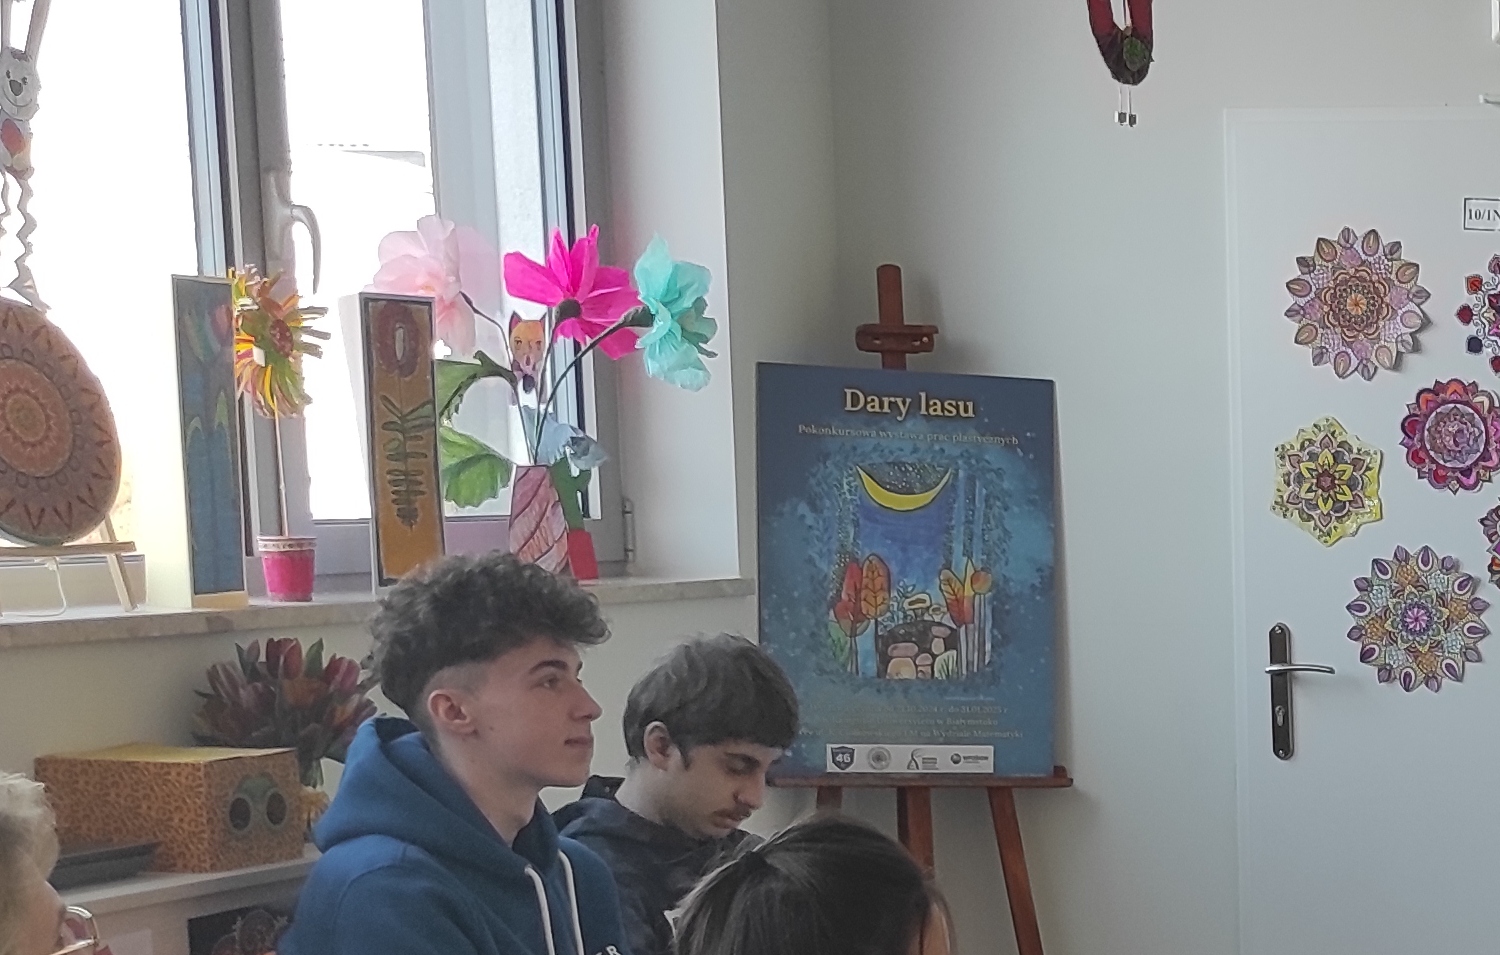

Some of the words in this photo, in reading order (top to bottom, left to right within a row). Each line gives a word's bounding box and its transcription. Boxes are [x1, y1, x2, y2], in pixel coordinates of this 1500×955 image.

[844, 388, 912, 422] Dary
[918, 391, 976, 419] lasu
[797, 424, 877, 438] Pokonkursowa
